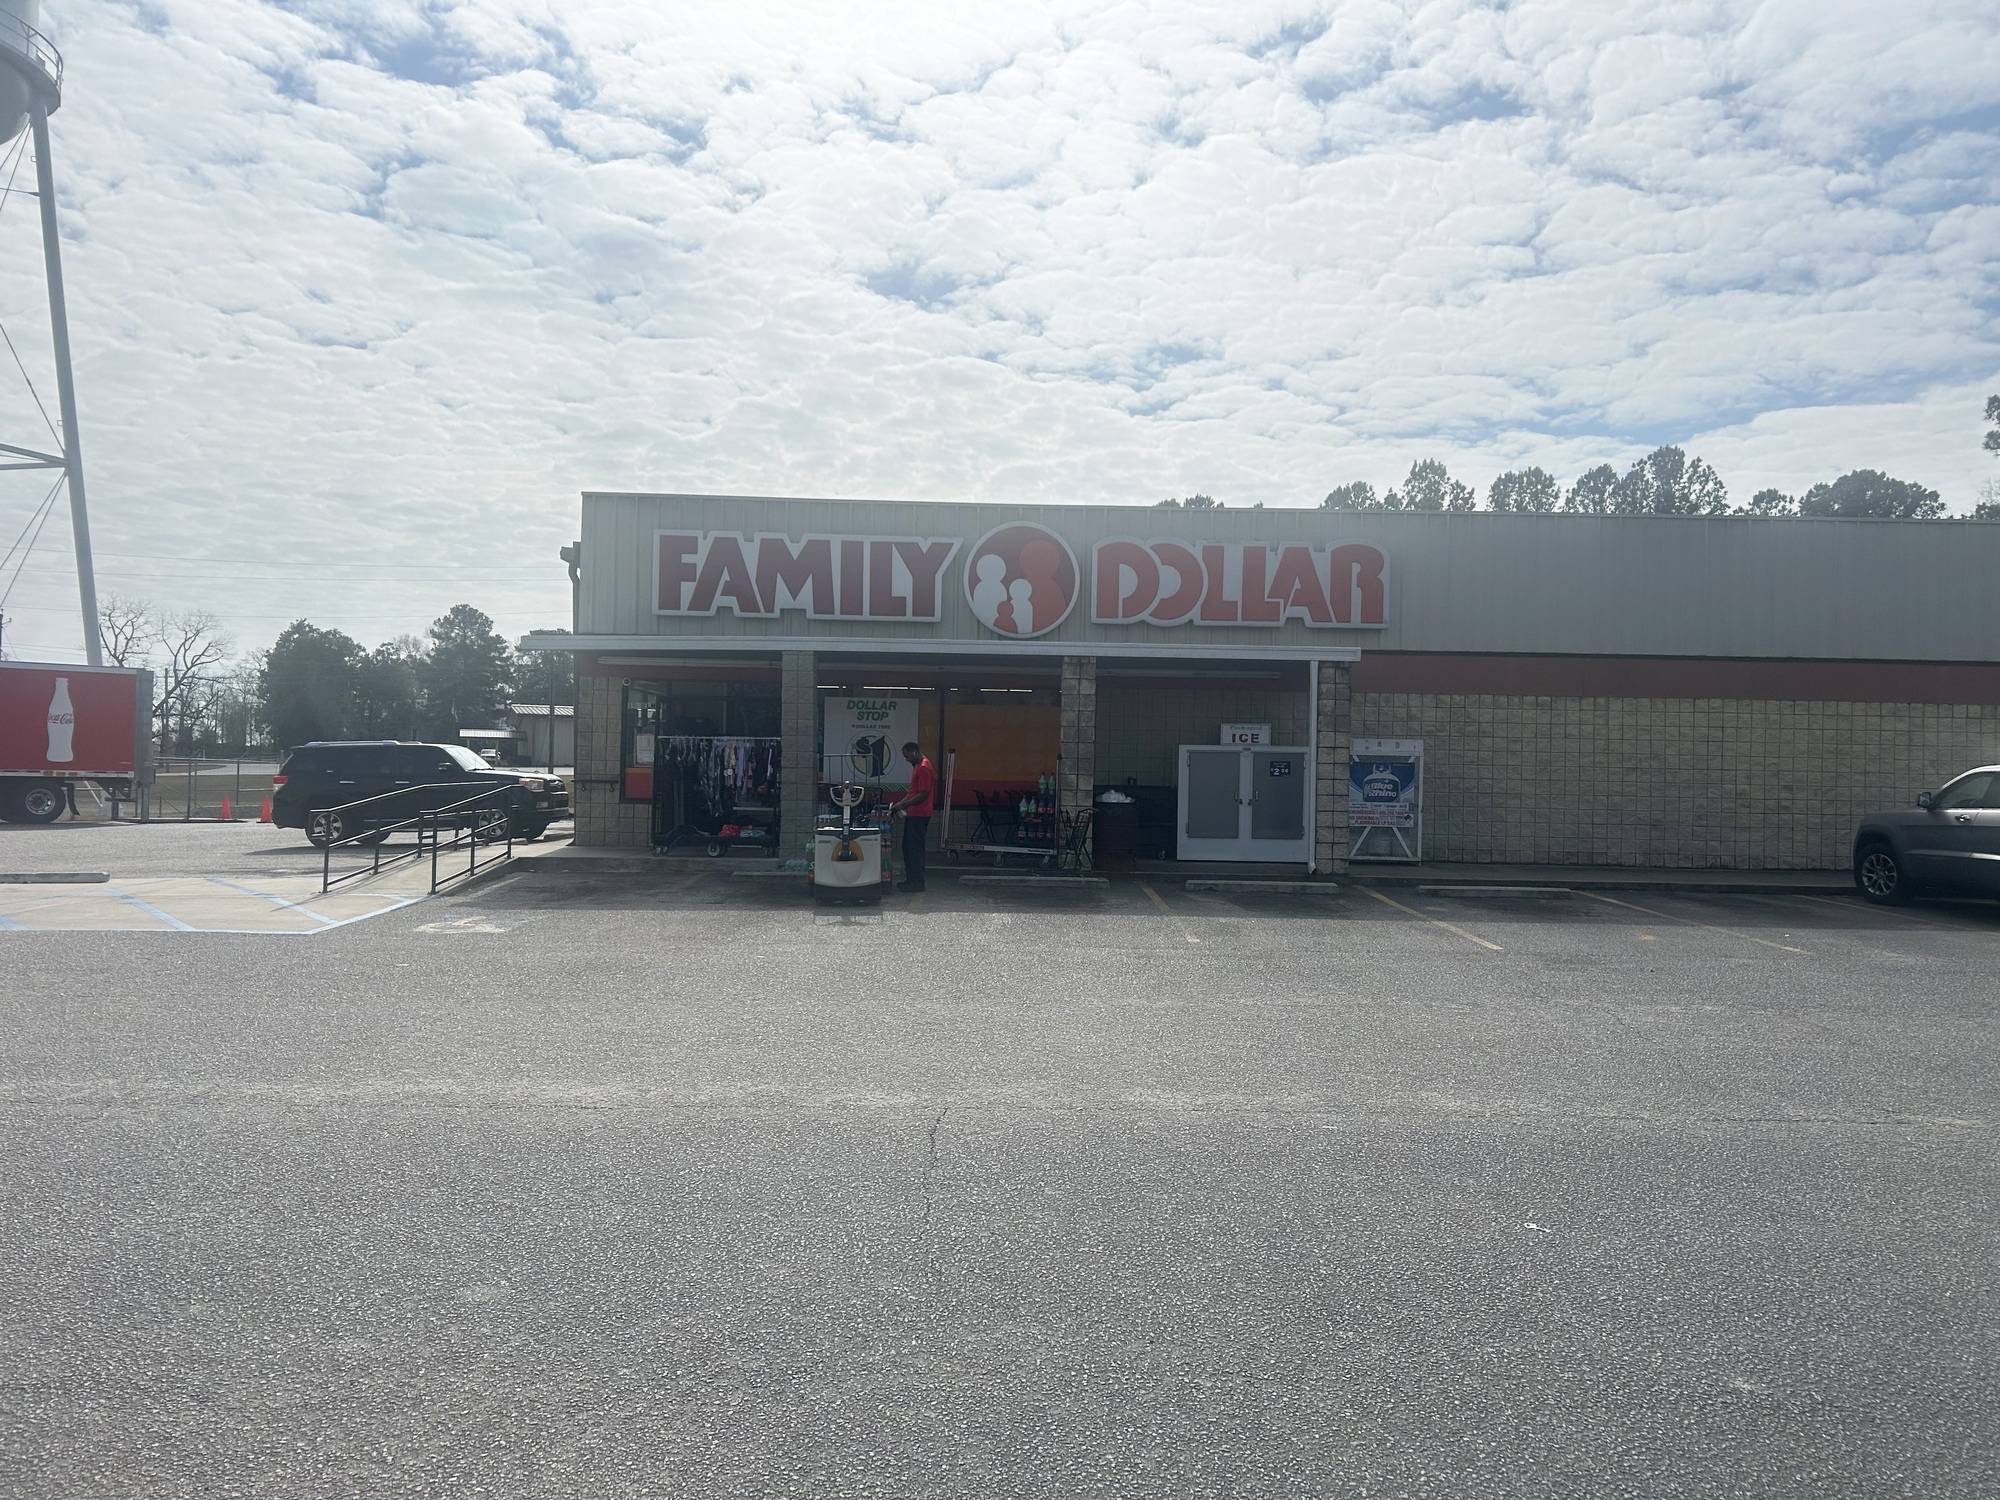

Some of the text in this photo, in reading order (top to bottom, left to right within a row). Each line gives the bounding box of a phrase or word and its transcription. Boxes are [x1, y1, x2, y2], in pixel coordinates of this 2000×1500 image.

[658, 535, 1385, 625] FAMILY DOLLAR
[846, 700, 897, 710] DOLLAR
[857, 711, 889, 721] STOP
[1232, 733, 1260, 743] ICE
[1369, 789, 1397, 797] Rhino
